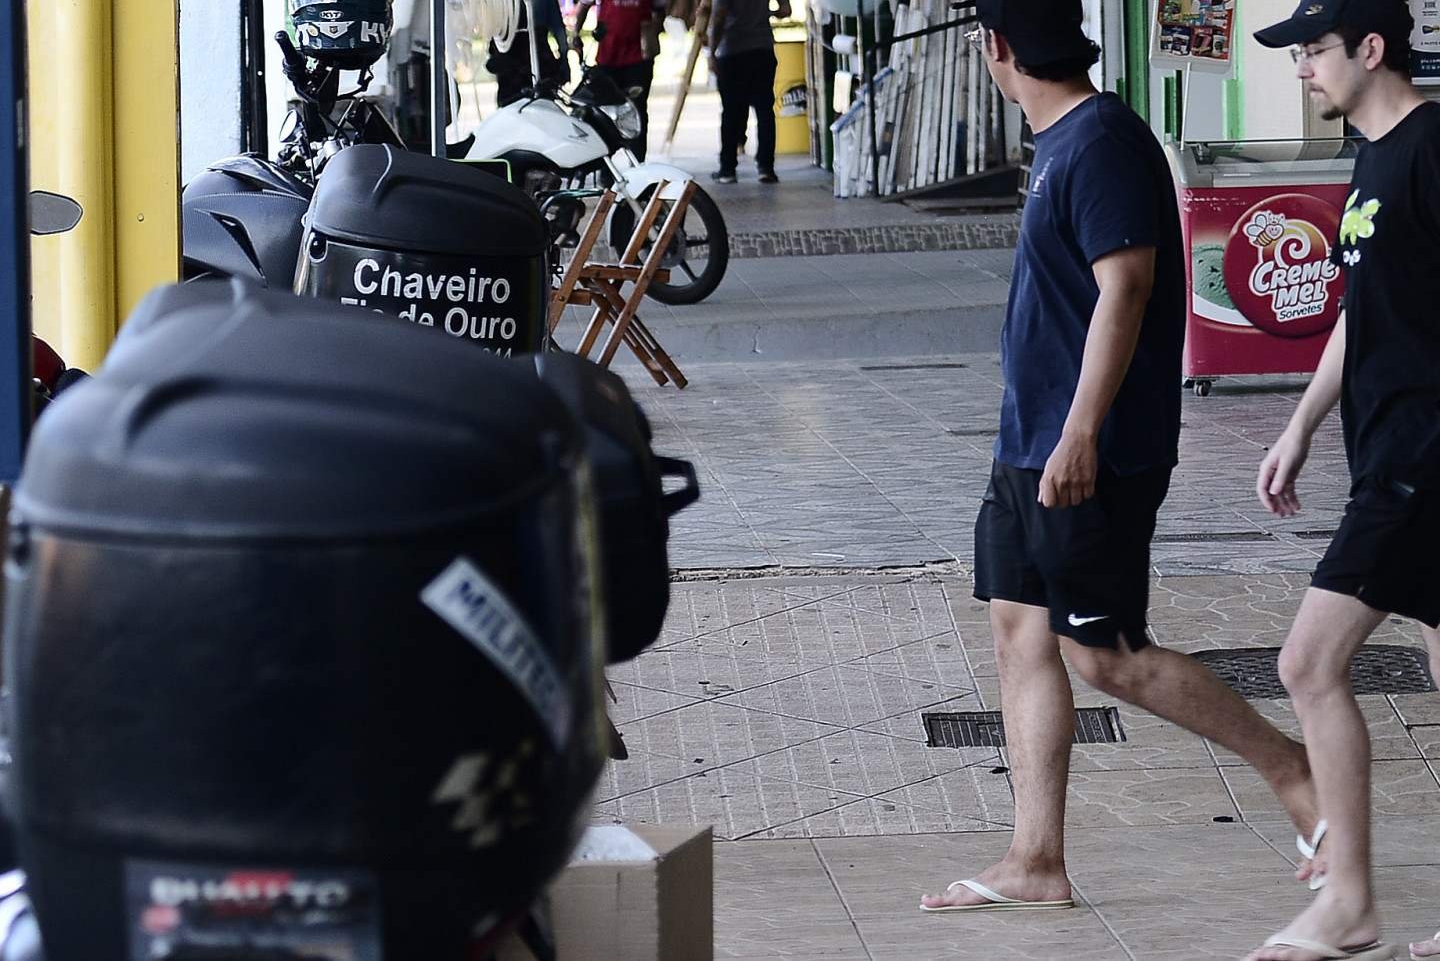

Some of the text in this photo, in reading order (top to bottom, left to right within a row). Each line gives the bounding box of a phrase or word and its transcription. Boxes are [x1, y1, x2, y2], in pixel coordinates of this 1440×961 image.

[354, 258, 511, 304] Chaveiro
[444, 306, 517, 340] Ouro
[1278, 304, 1323, 320] Sorvetes
